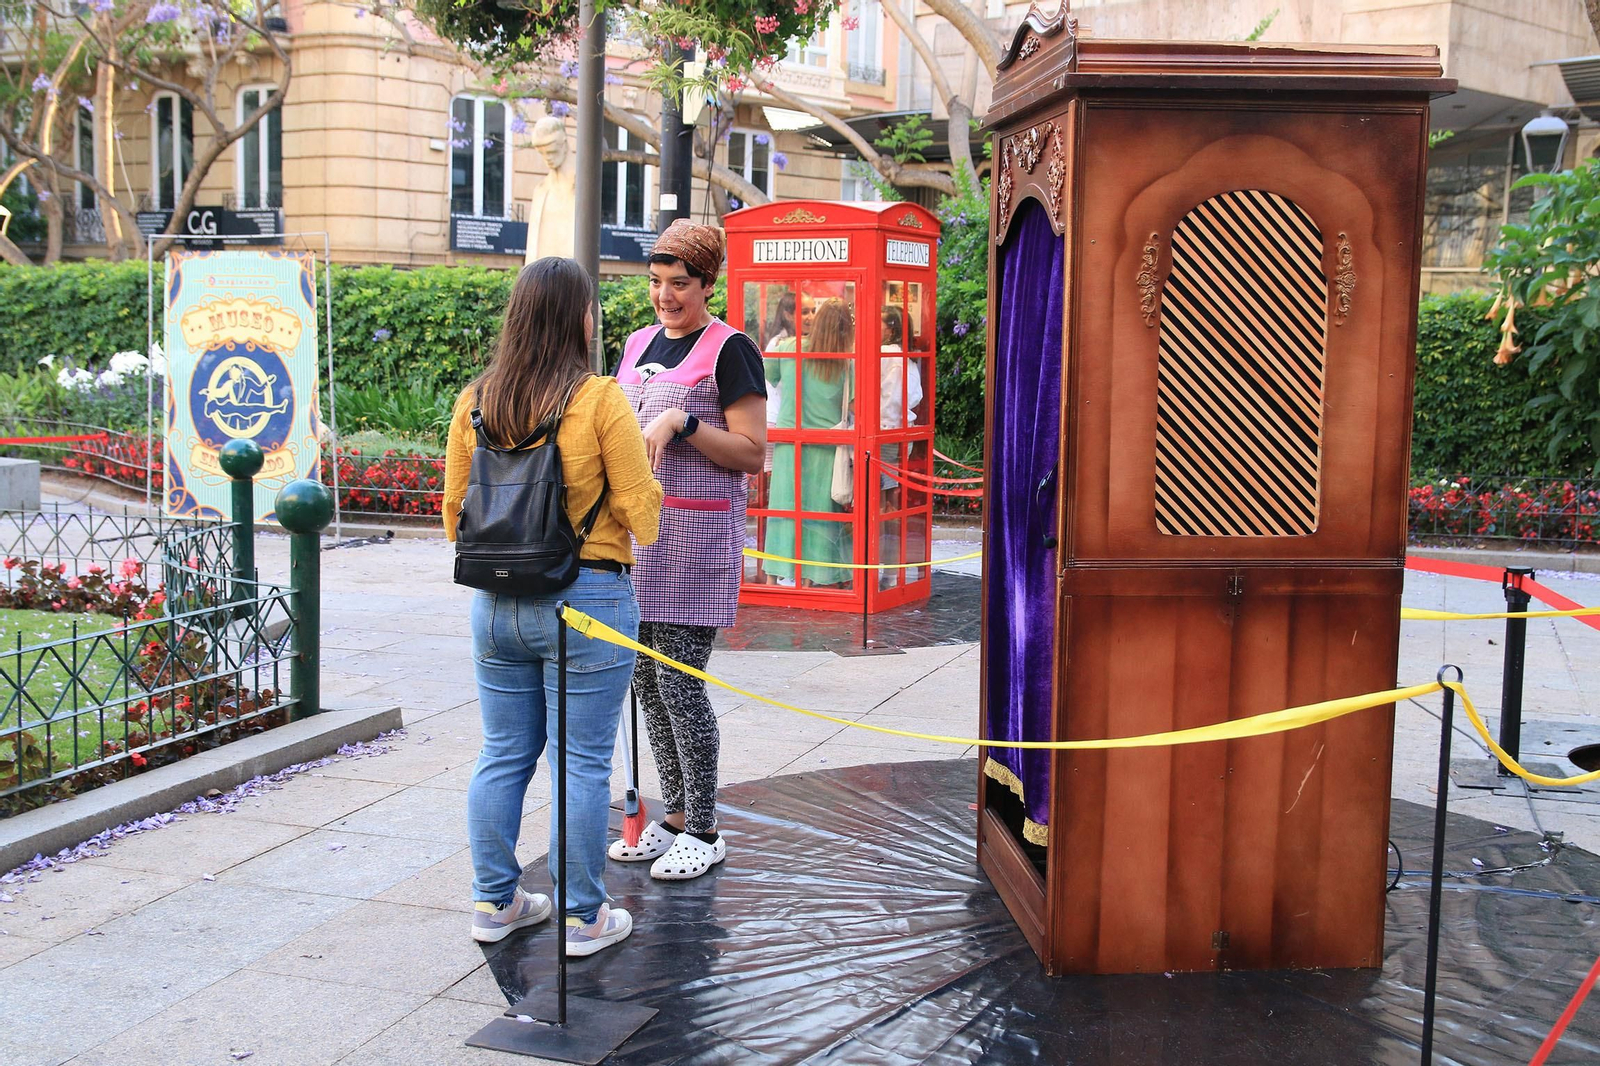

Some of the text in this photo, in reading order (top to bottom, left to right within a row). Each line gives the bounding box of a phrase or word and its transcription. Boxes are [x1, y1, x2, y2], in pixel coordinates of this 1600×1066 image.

[755, 240, 848, 261] TELEPHONE
[887, 240, 929, 264] TELEPHONE
[208, 310, 274, 333] MUSEO
